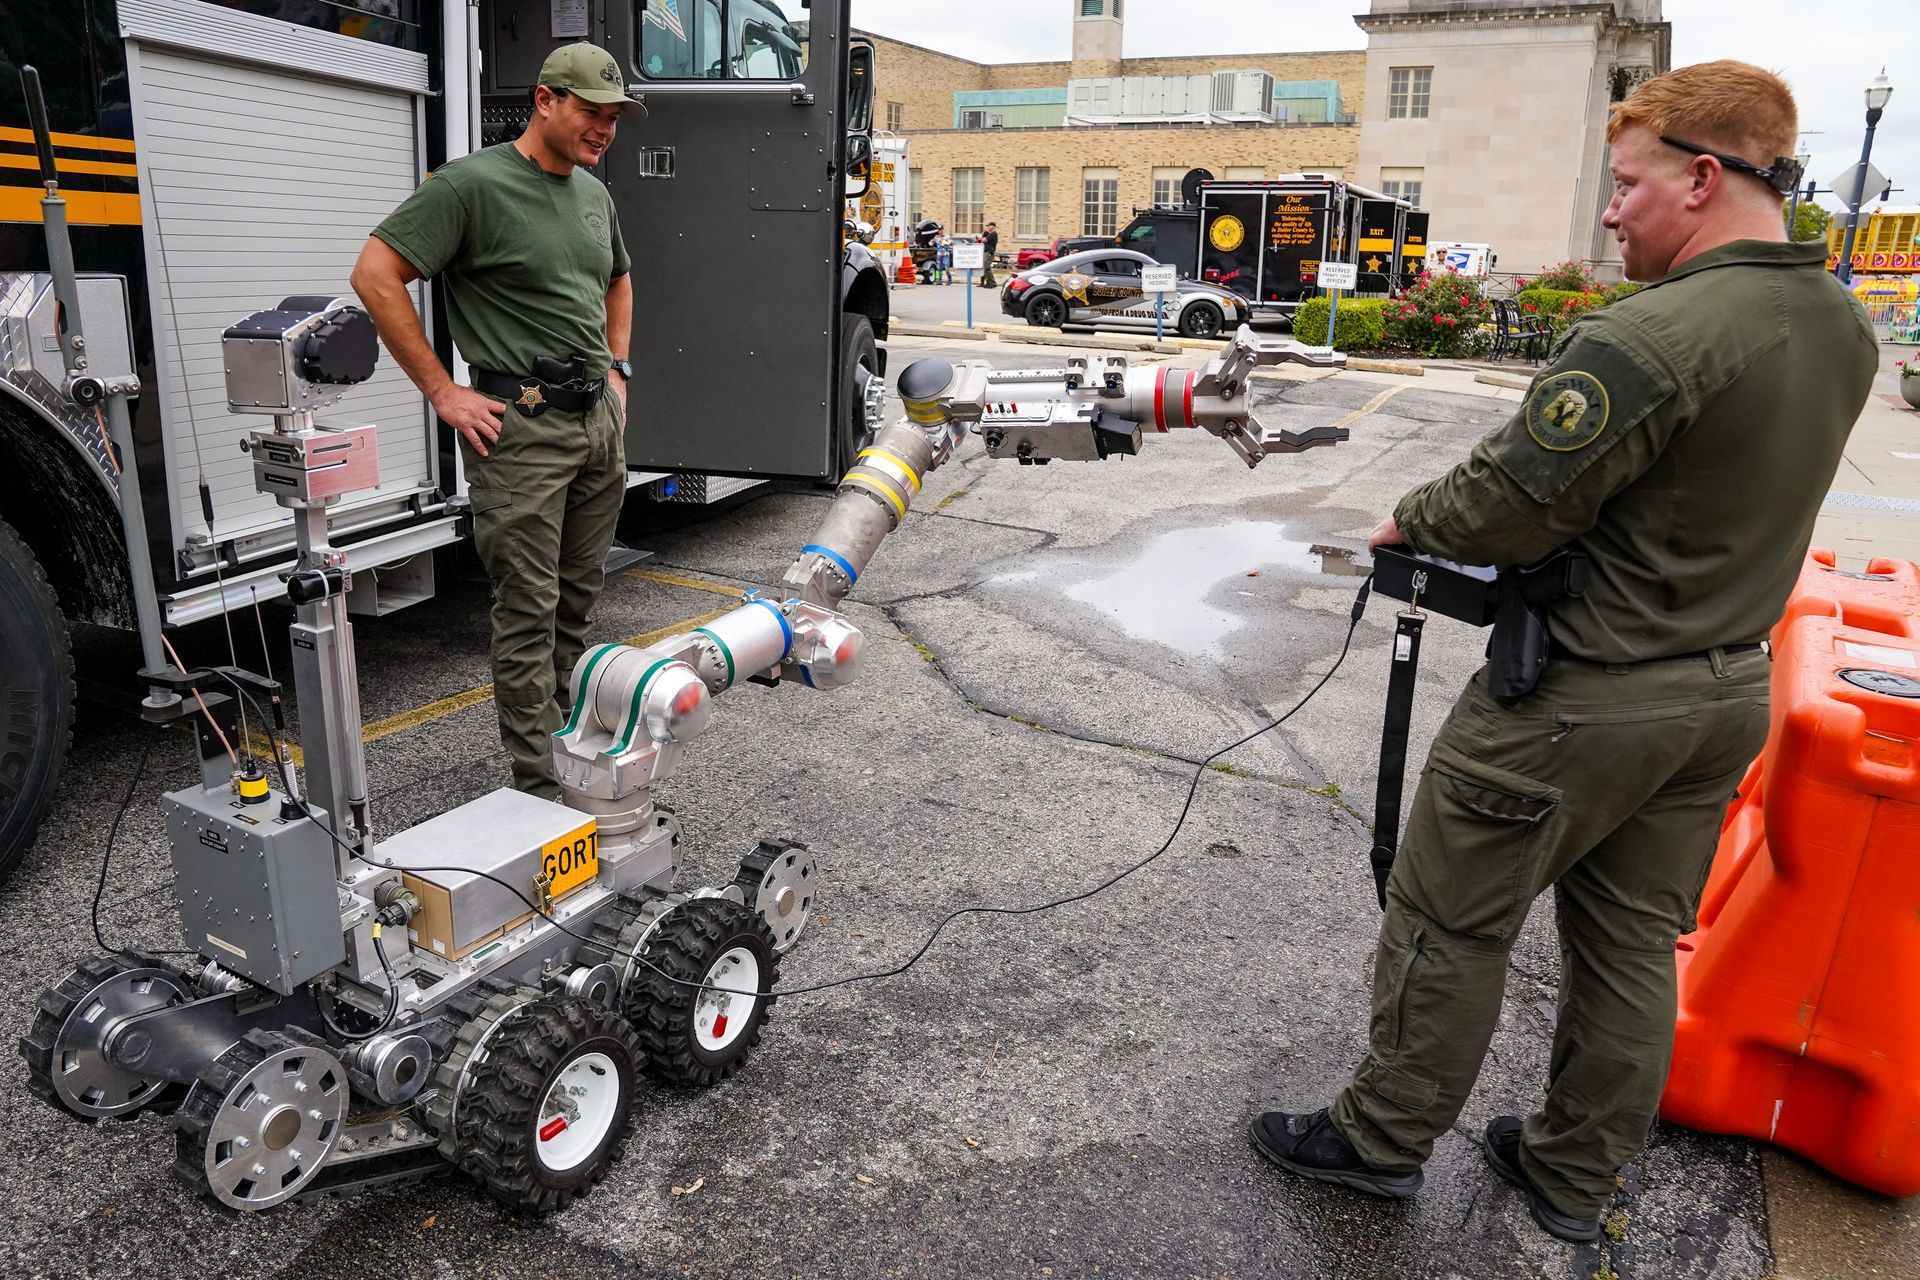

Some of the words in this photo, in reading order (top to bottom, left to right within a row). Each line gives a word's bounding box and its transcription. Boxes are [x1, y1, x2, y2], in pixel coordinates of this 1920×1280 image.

[1286, 195, 1302, 203] Our
[1278, 204, 1310, 212] Mission
[1369, 228, 1384, 236] EXIT
[1108, 308, 1125, 317] FROM
[1130, 310, 1147, 319] DRUG
[1147, 311, 1170, 320] DEAER
[1555, 378, 1601, 414] SWAT
[544, 831, 597, 882] GORT
